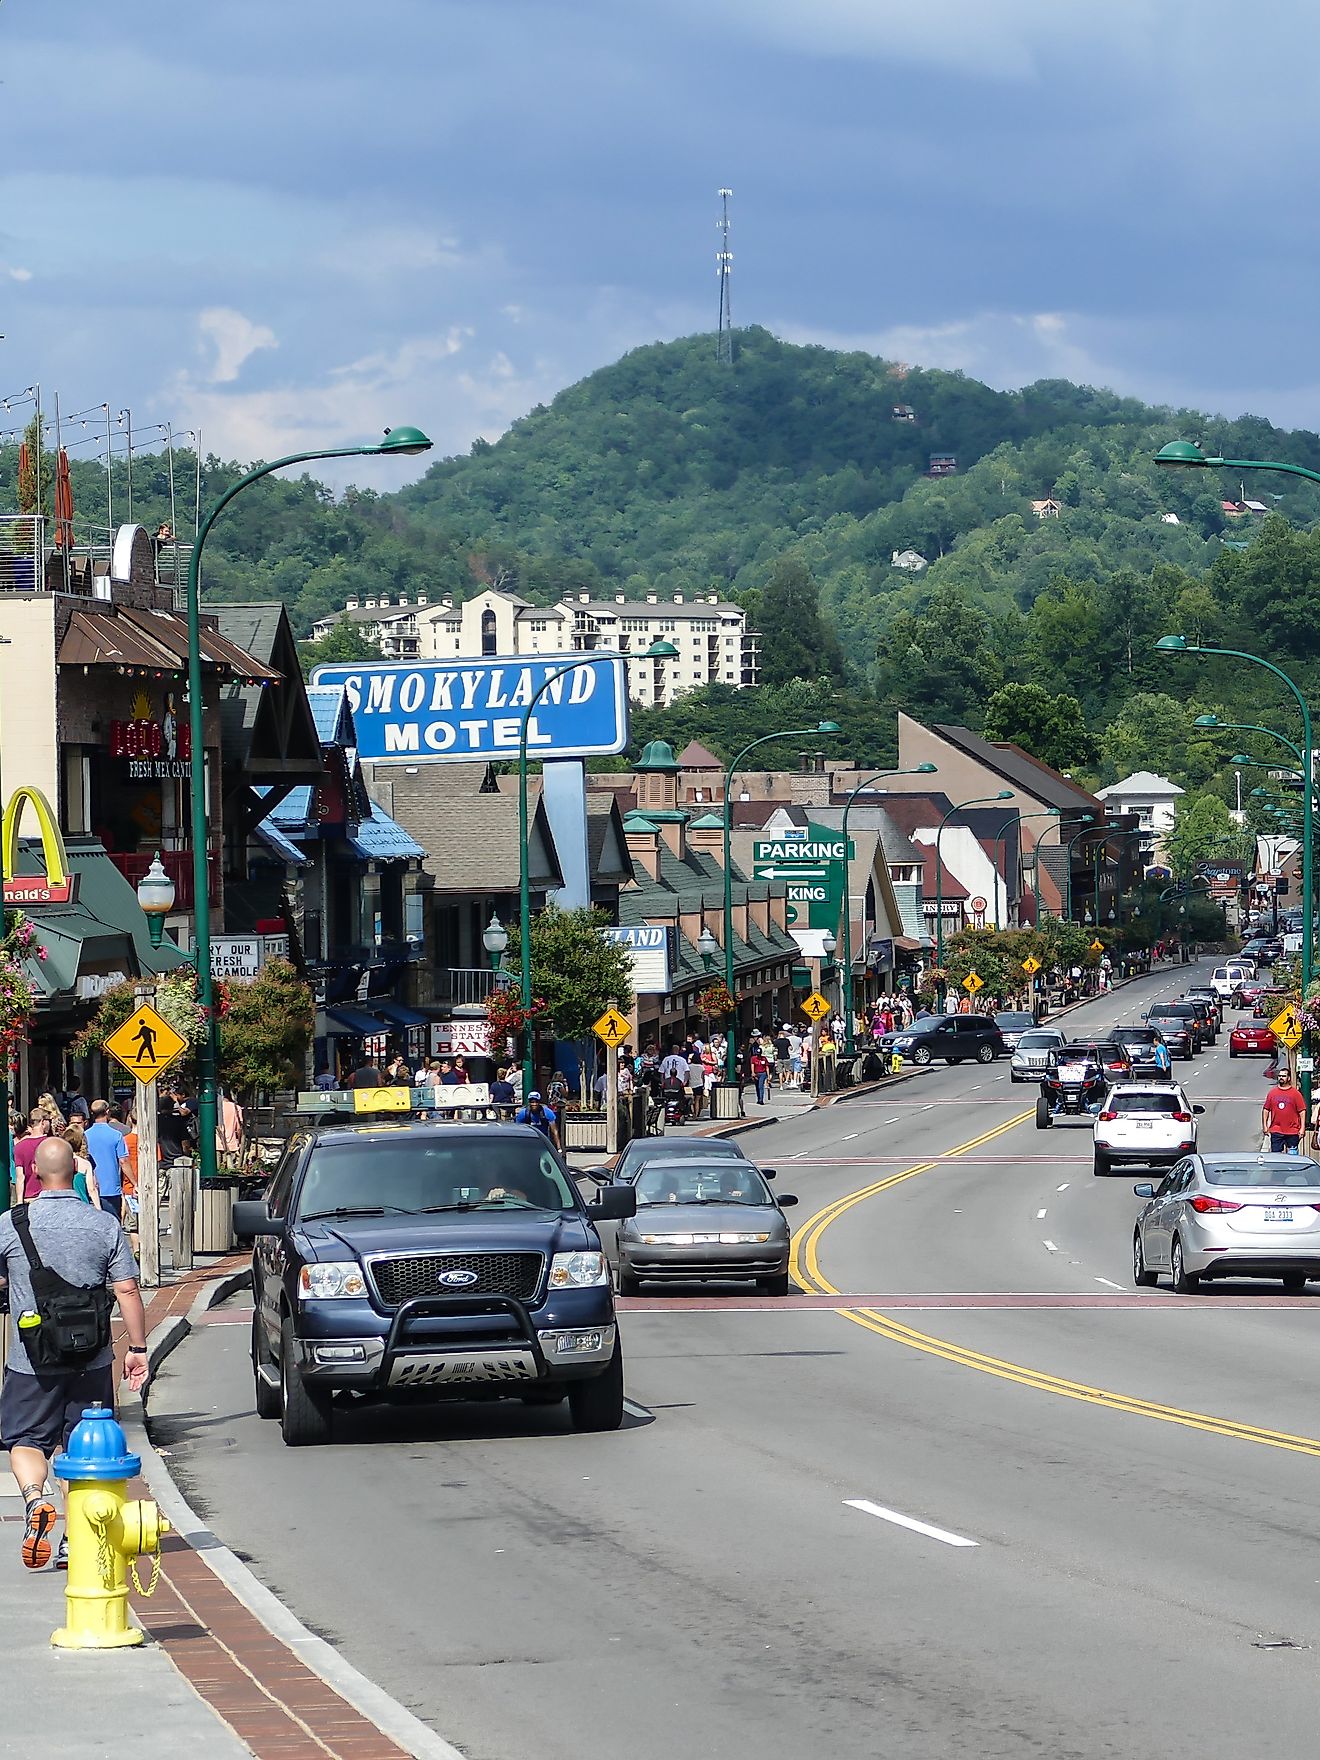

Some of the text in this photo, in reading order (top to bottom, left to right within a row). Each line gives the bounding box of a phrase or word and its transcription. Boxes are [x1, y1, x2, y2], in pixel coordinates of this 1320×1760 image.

[347, 663, 597, 716] SMOKYLAND
[384, 716, 552, 752] MOTEL
[129, 761, 192, 778] FRESH MEX CANTI
[759, 842, 845, 859] PARKING
[4, 889, 51, 900] nald's
[788, 887, 826, 900] KING
[609, 928, 663, 947] LAND
[209, 945, 251, 955] RY OUR
[210, 956, 243, 966] FRESH
[211, 967, 258, 976] ACAMOLE
[434, 1024, 489, 1033] TENNES
[436, 1041, 489, 1054] BAN
[446, 1272, 470, 1283] Ford
